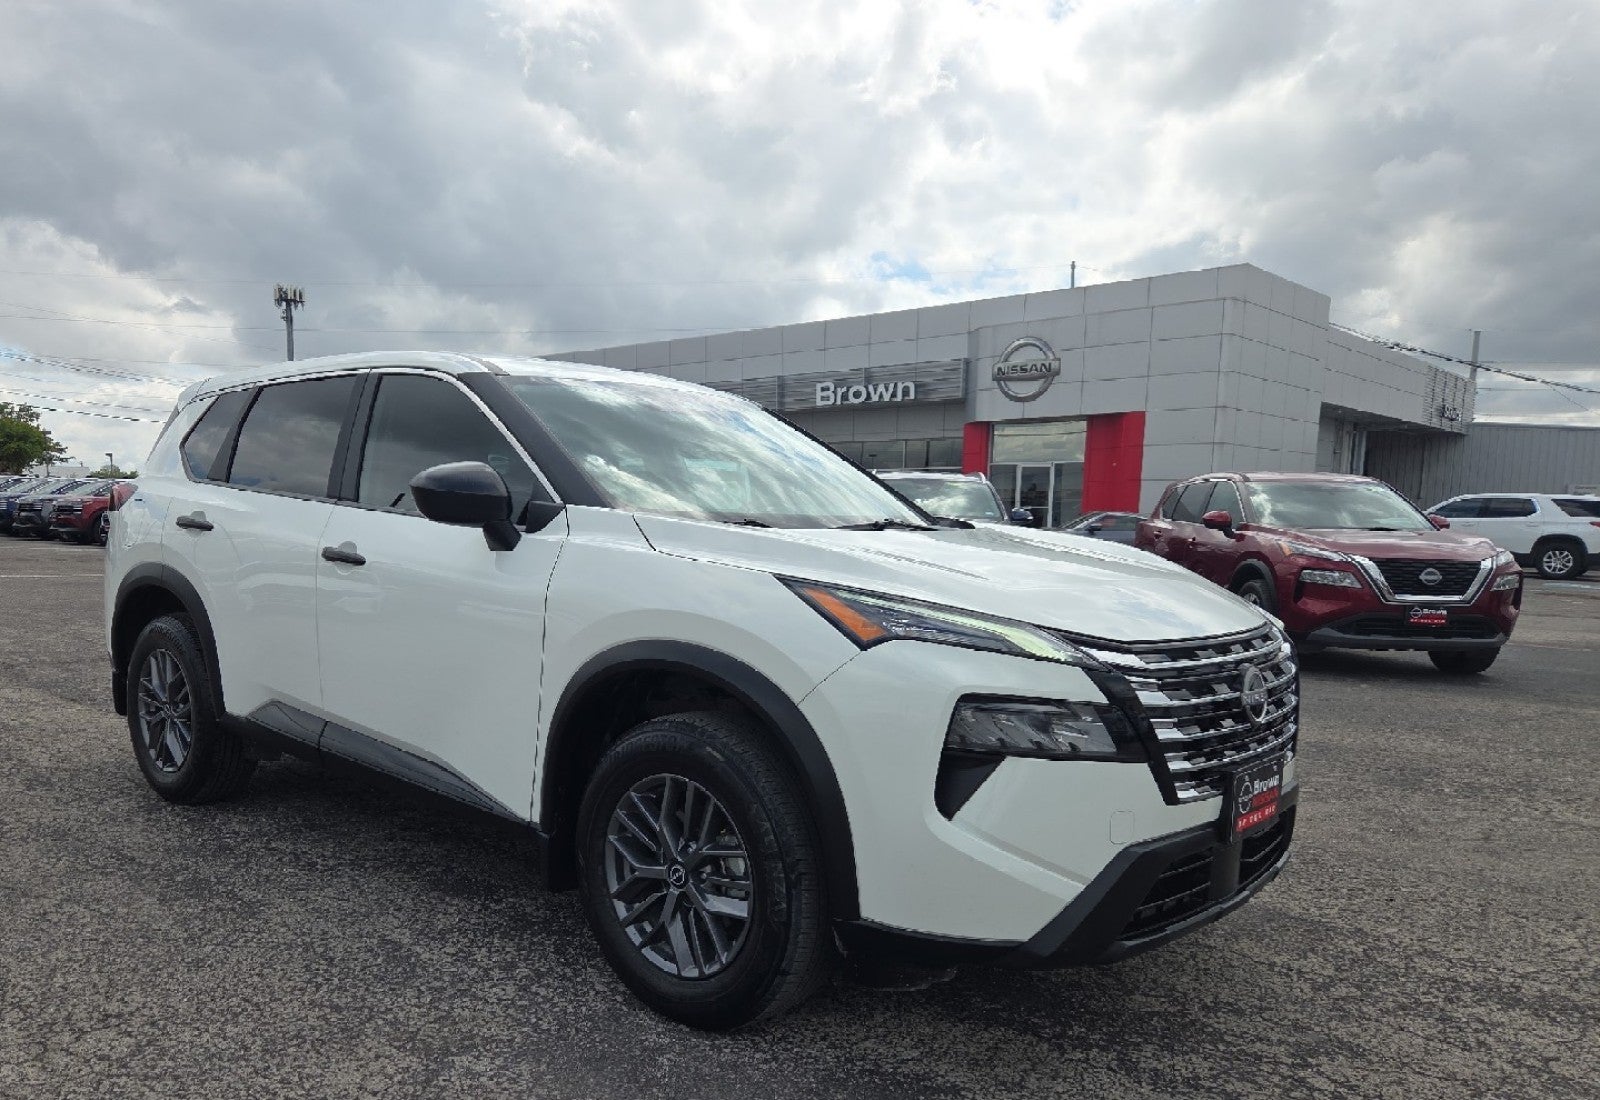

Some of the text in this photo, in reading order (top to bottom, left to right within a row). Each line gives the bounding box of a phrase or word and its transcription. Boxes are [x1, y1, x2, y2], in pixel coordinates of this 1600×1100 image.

[996, 362, 1052, 377] NISSAN
[815, 381, 916, 407] Brown
[1253, 774, 1280, 795] Brown
